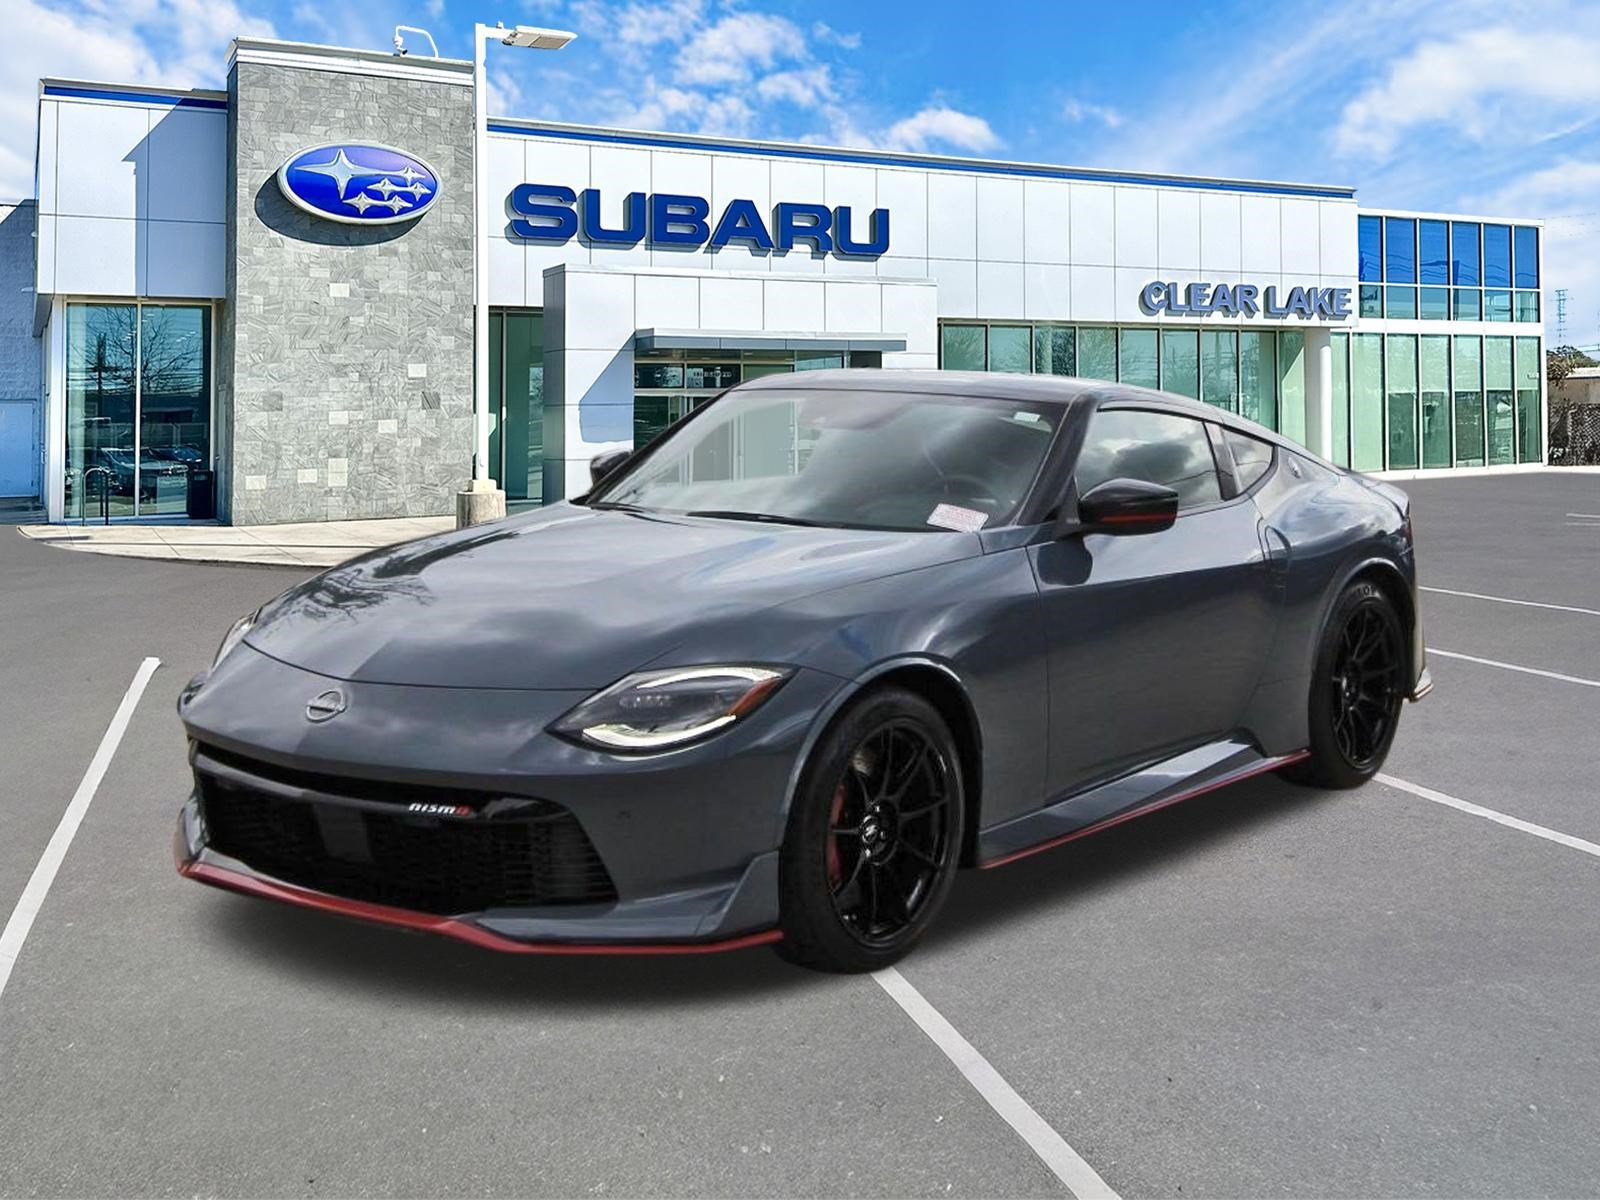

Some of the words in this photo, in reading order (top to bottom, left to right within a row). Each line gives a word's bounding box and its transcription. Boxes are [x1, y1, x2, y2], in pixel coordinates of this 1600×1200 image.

[505, 183, 890, 261] SUBARU
[1139, 280, 1260, 319] CLEAR
[1263, 285, 1353, 320] LAKE
